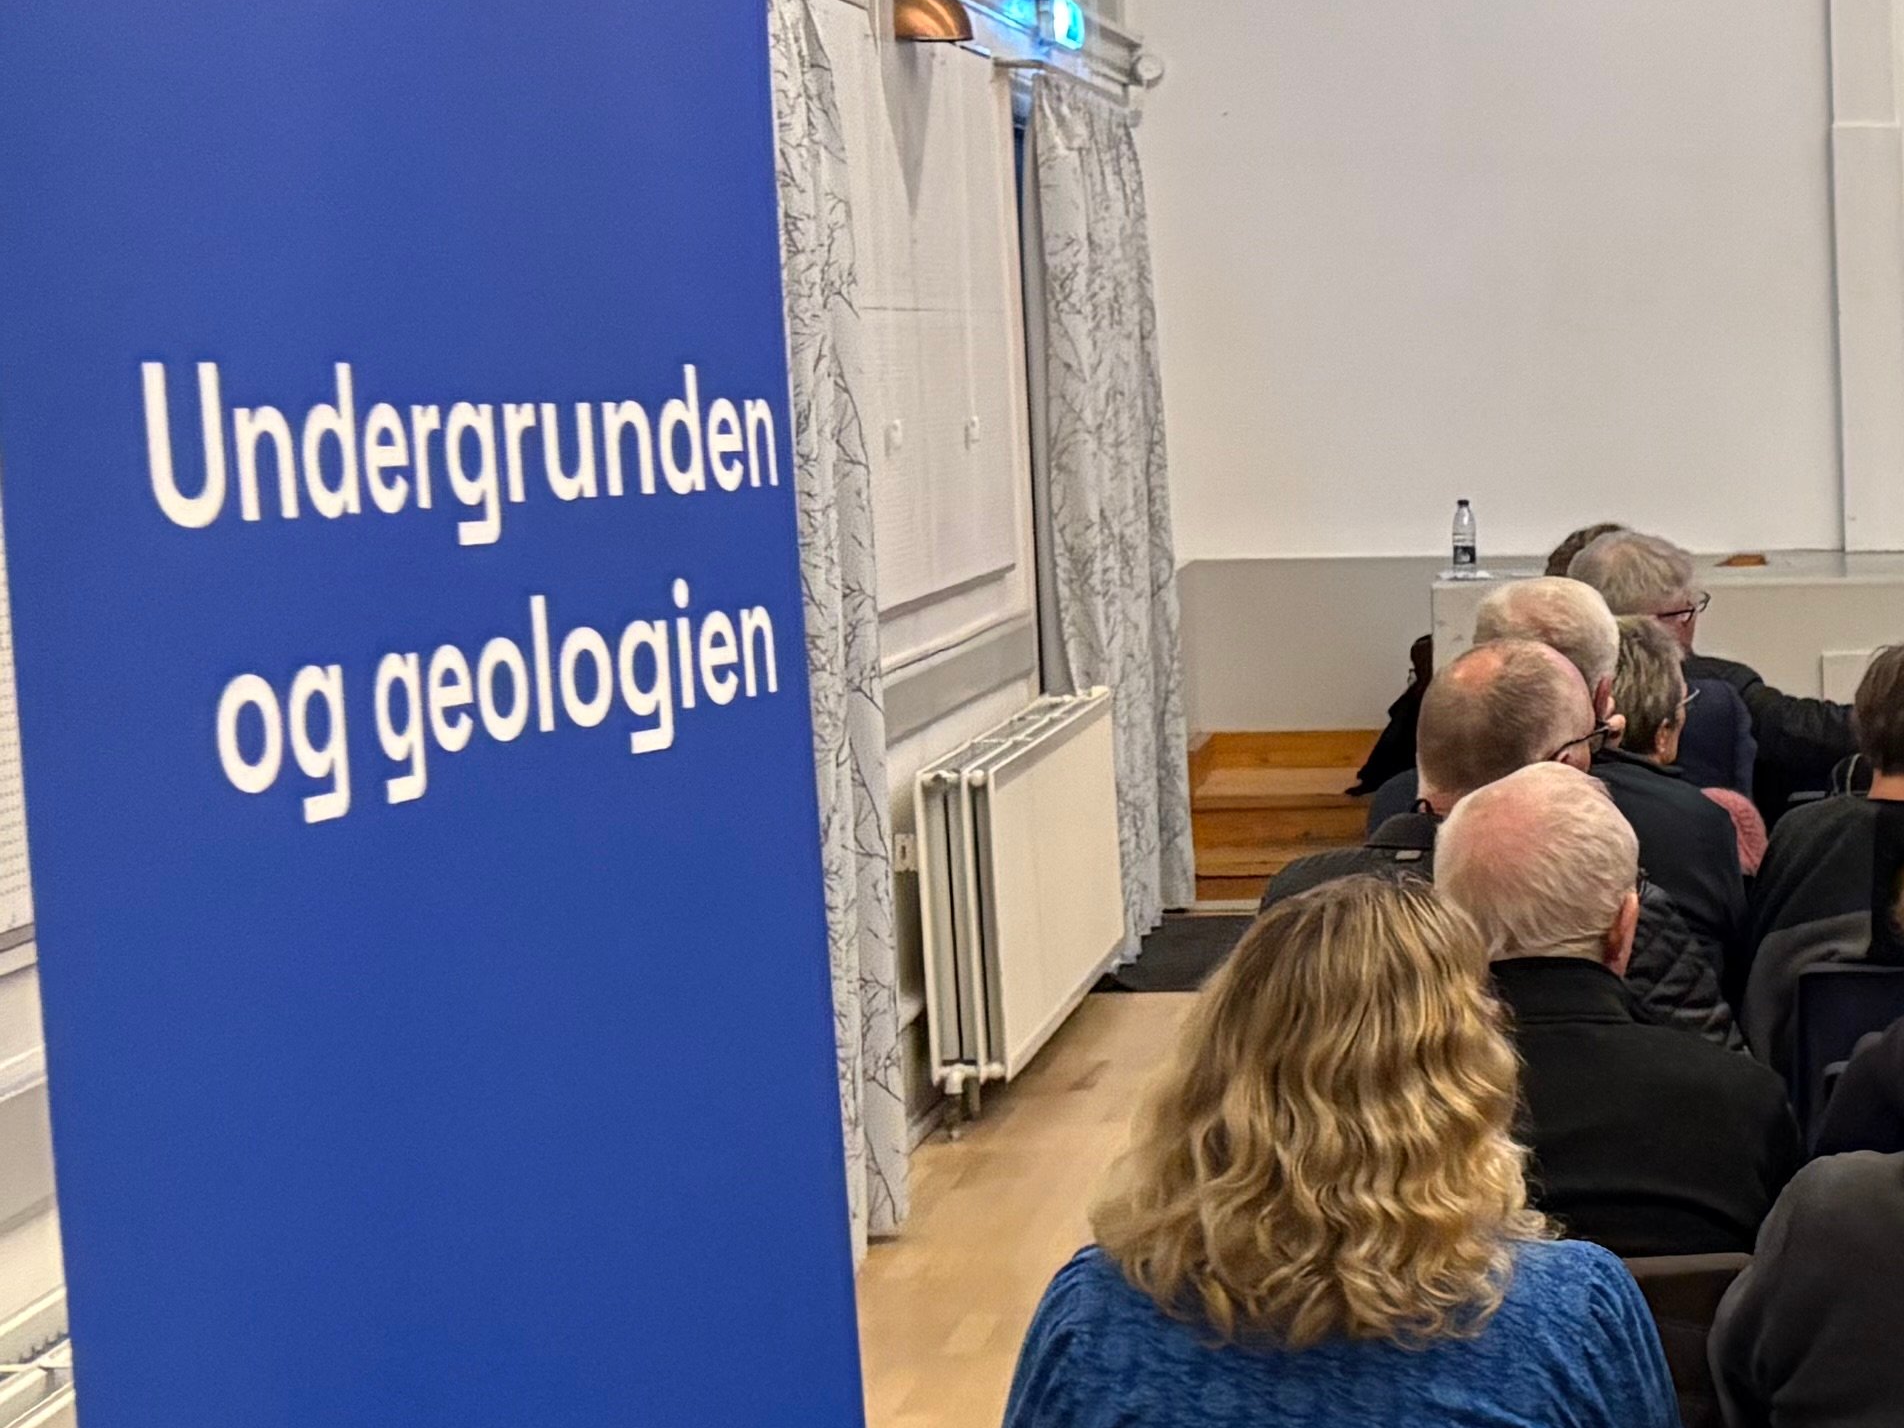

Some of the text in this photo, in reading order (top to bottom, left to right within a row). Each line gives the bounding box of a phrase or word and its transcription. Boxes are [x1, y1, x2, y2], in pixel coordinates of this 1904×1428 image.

[141, 361, 780, 546] Undergrunden
[216, 578, 779, 824] og geologien
